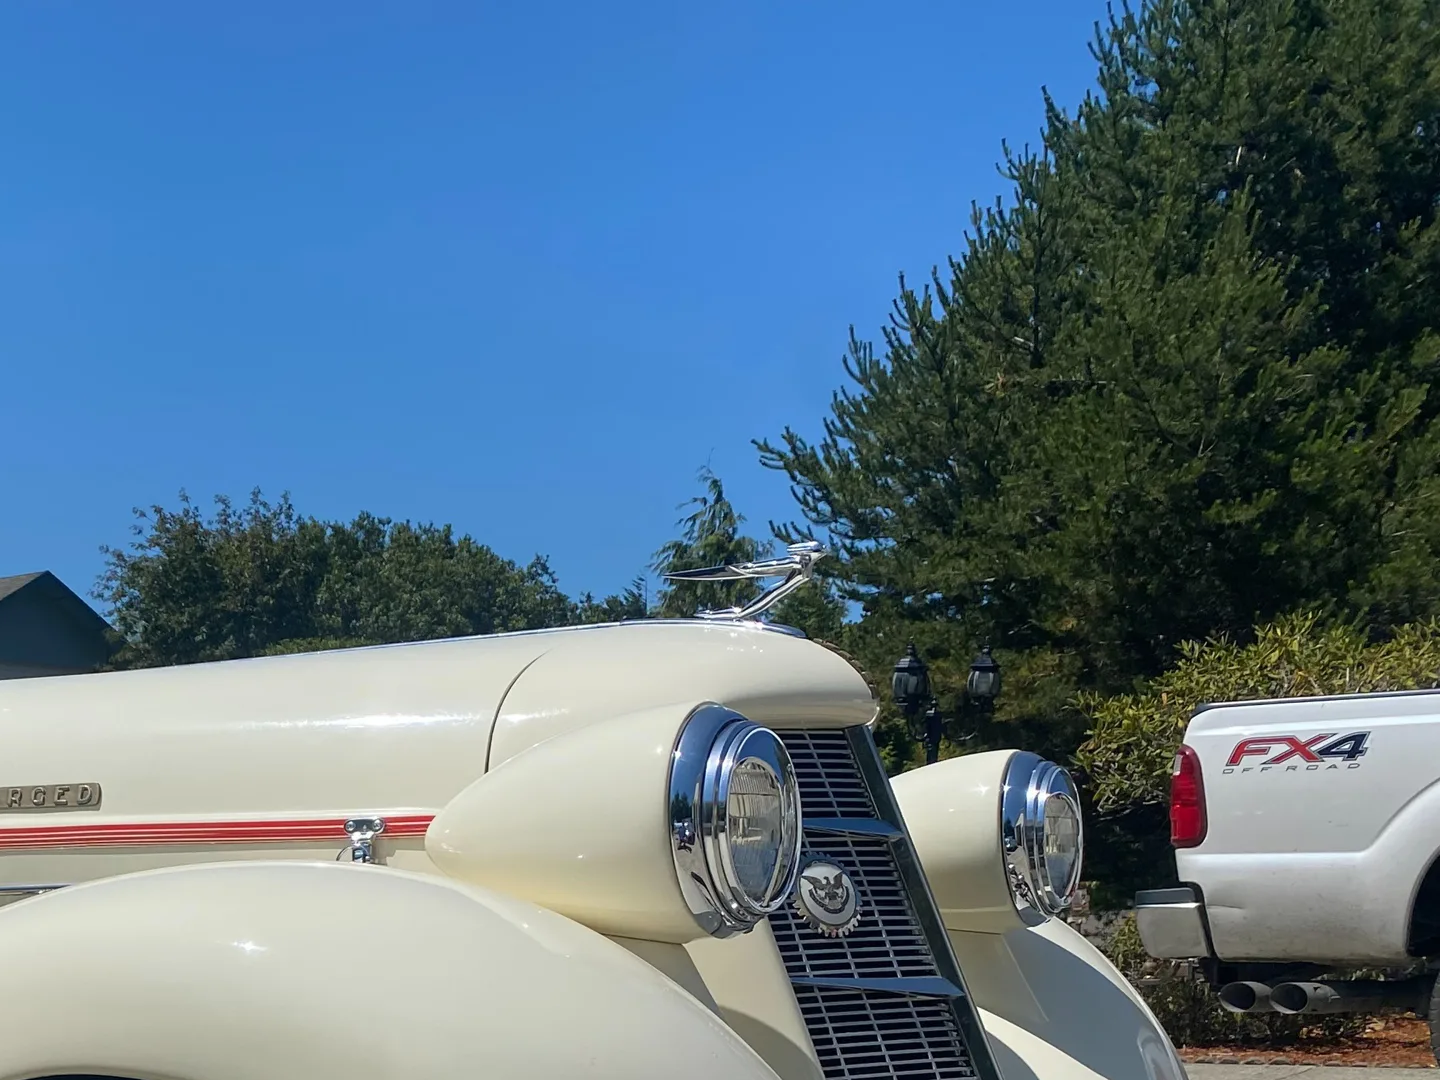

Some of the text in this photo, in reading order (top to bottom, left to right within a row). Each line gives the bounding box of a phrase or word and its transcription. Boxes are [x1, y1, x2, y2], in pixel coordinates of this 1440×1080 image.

[1225, 731, 1371, 766] FX4
[1222, 763, 1361, 775] OFF ROAD
